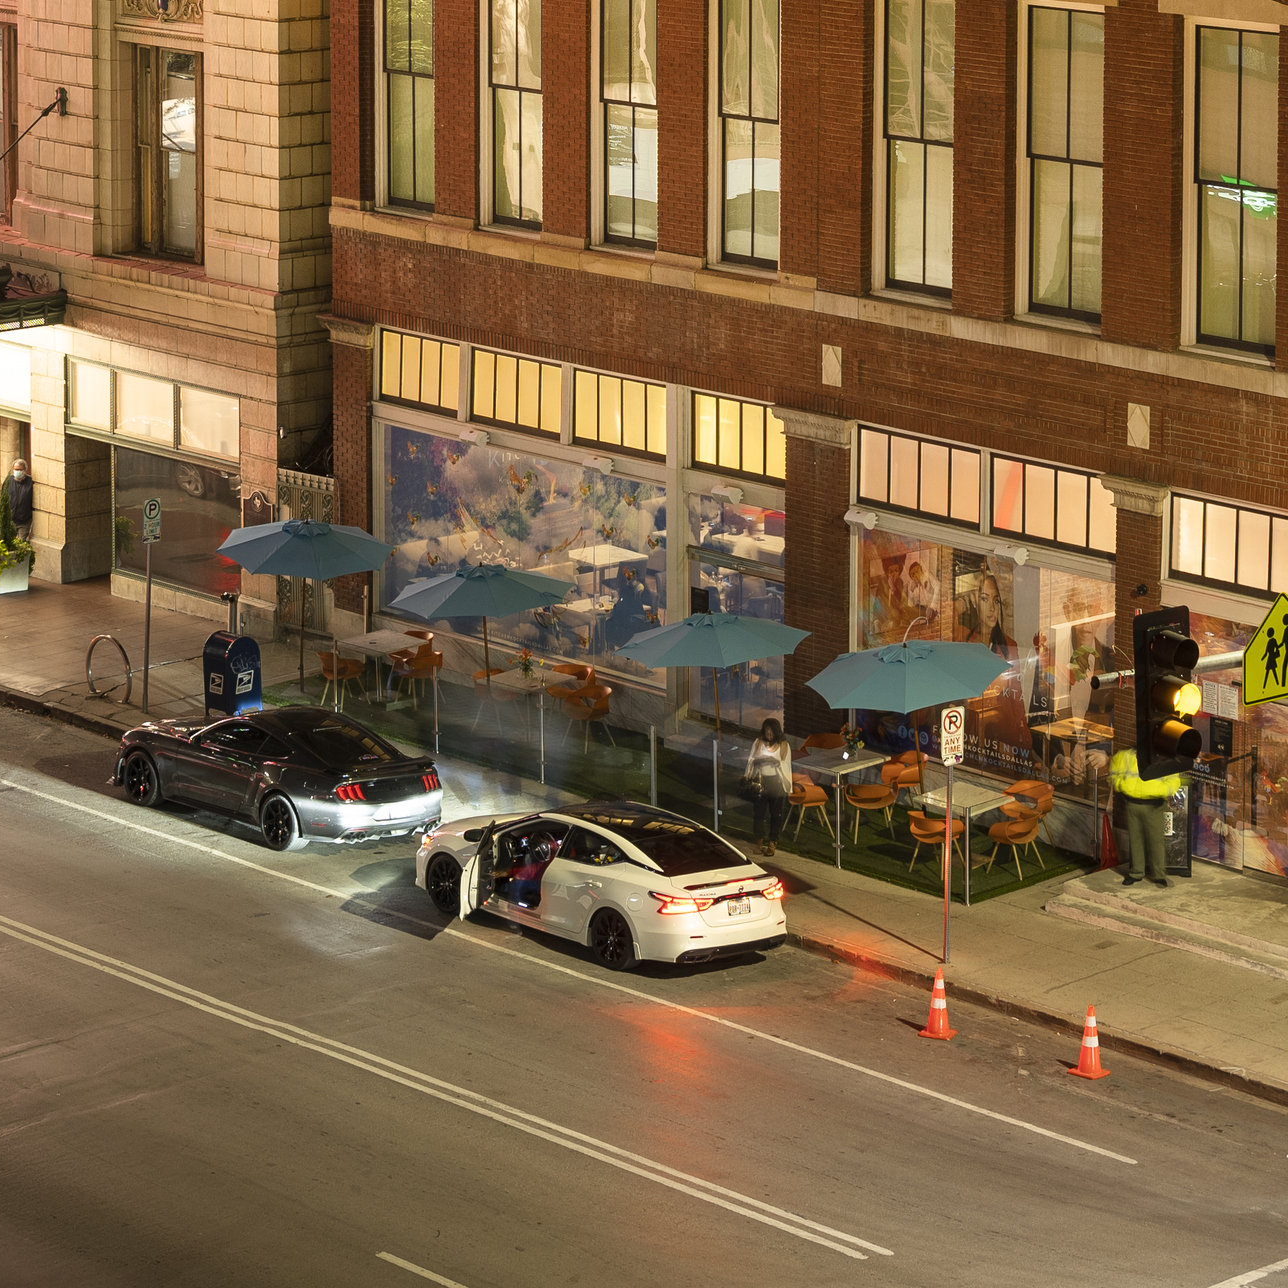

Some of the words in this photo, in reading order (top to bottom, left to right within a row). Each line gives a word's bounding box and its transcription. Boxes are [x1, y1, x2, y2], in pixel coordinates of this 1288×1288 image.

[944, 736, 961, 747] ANY
[943, 745, 962, 755] TIME
[984, 737, 998, 750] US
[1002, 742, 1030, 760] NOW
